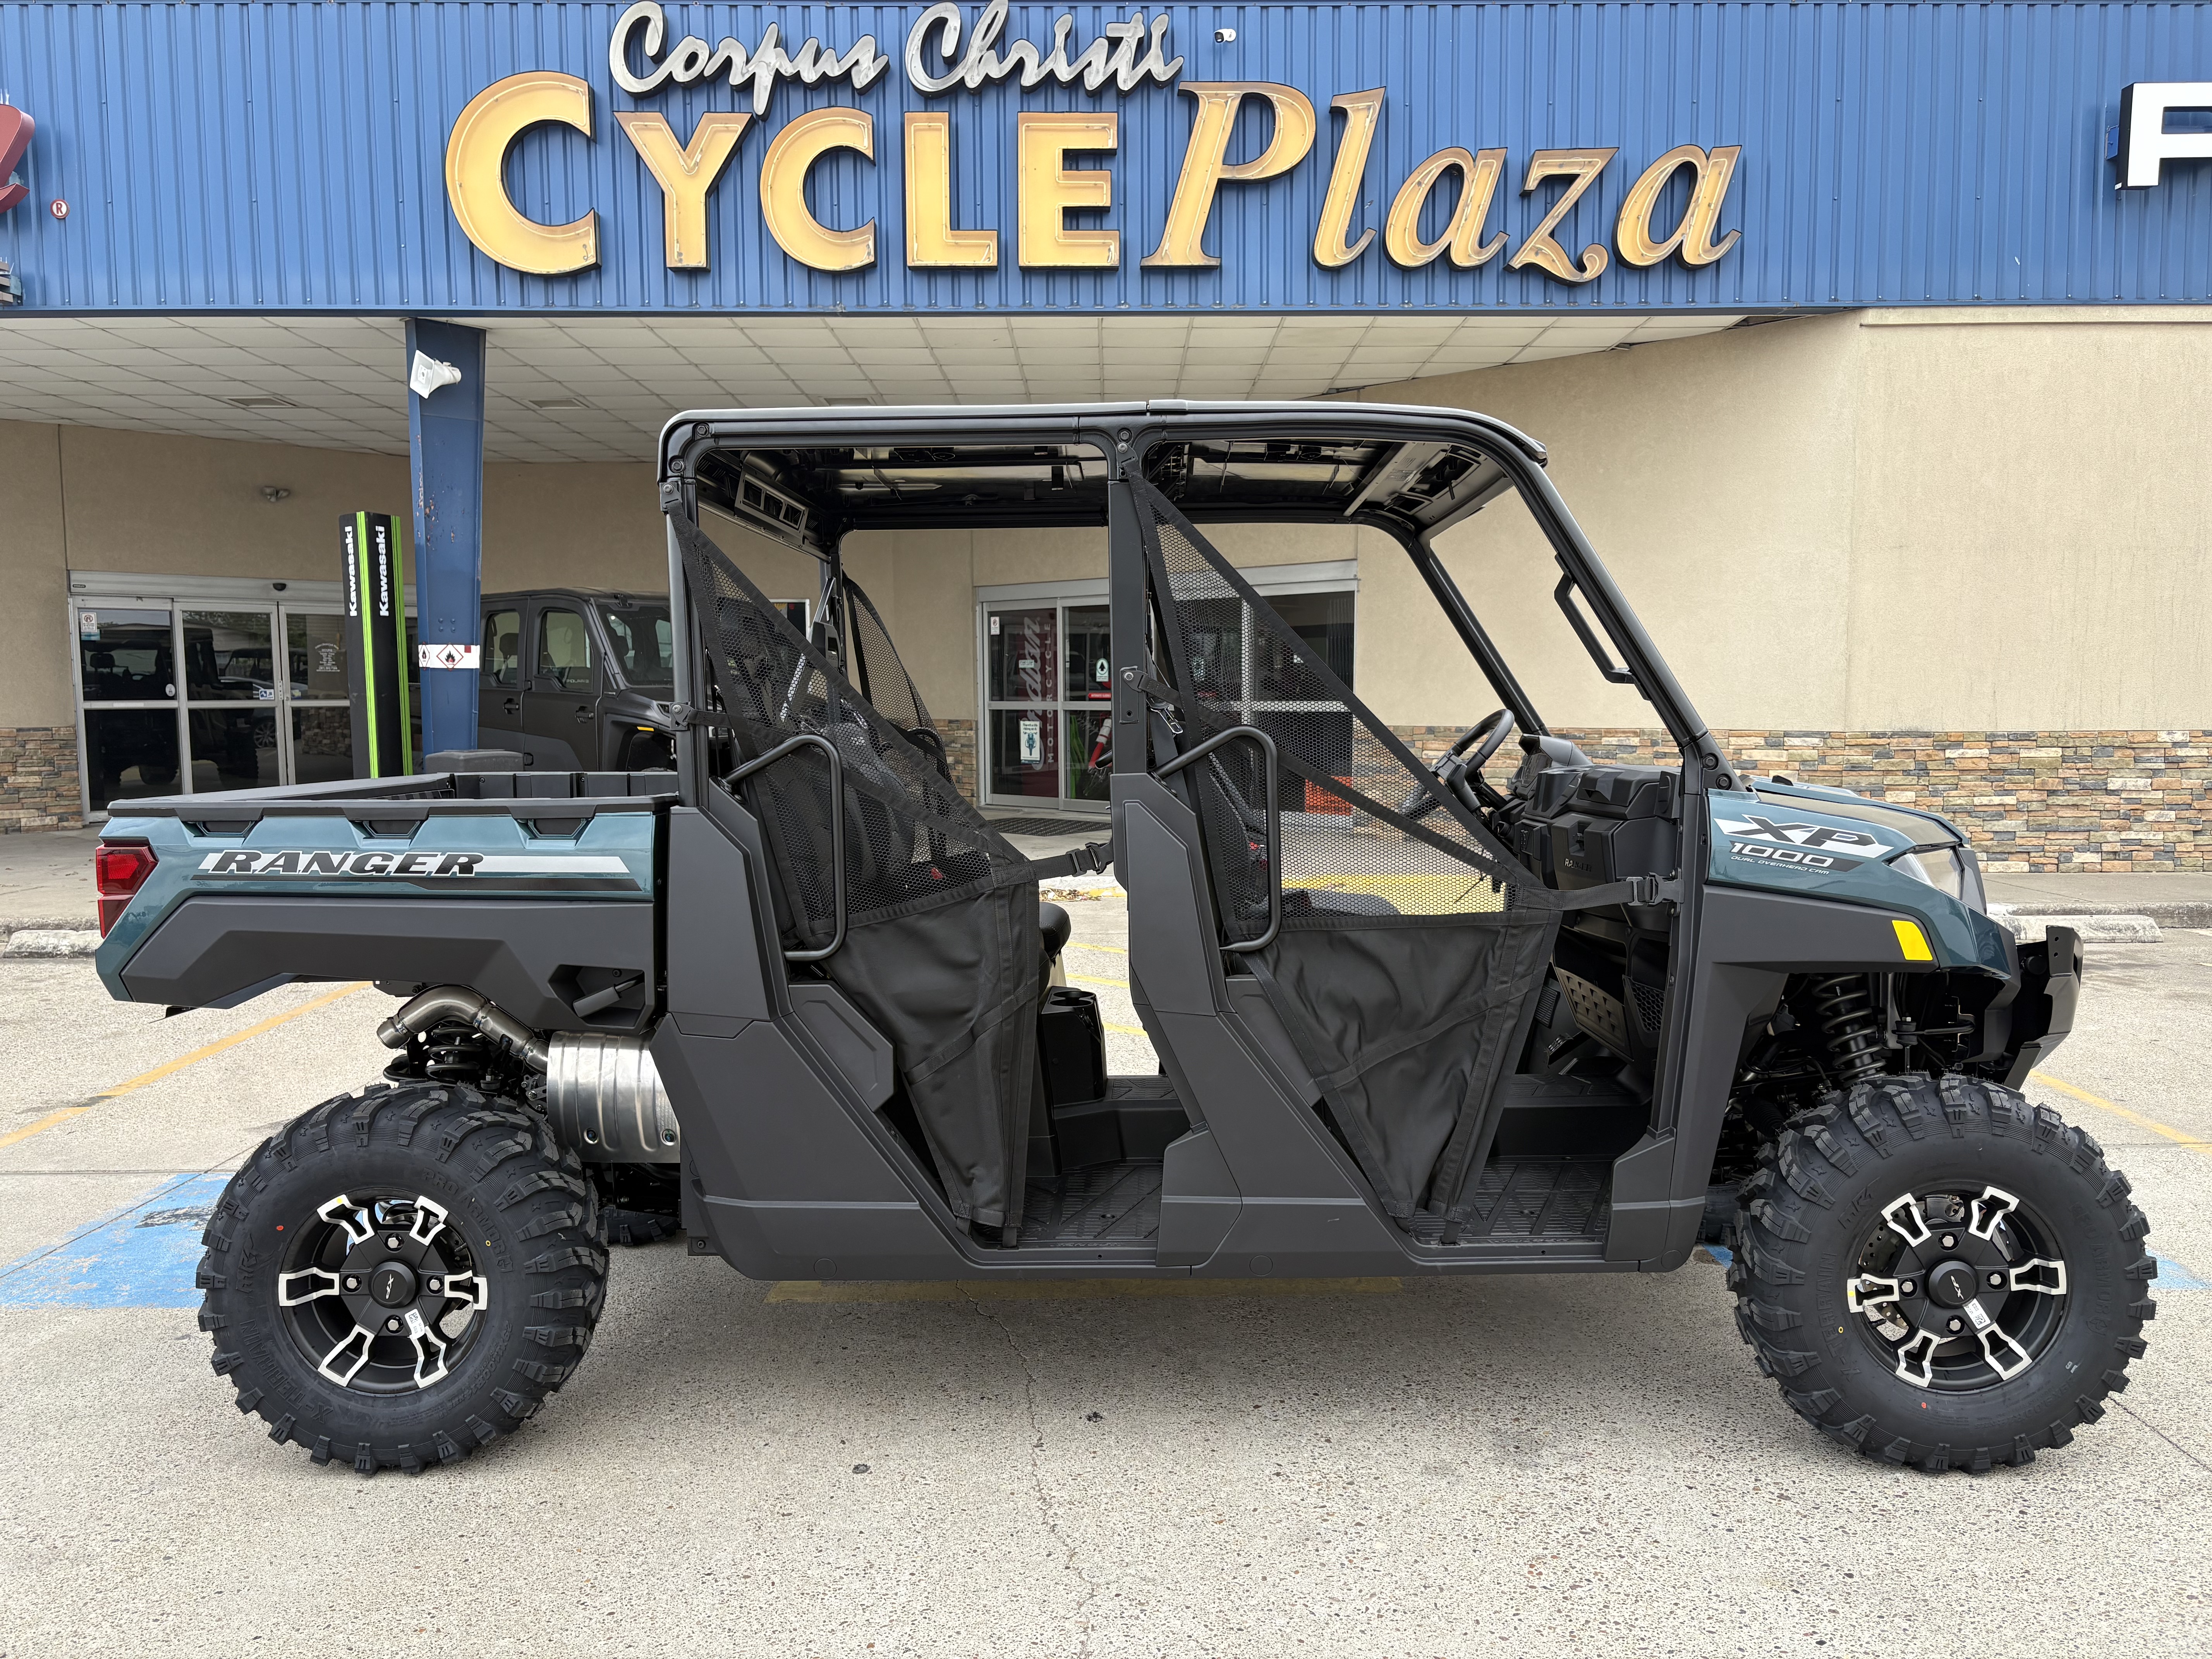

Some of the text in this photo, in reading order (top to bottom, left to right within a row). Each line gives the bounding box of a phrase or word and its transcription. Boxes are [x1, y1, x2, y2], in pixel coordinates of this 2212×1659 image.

[609, 0, 1184, 116] Corpus Christi
[445, 71, 1743, 286] CYCLE Plaza
[345, 526, 357, 616] Kawasaki
[376, 526, 389, 616] Kawasaki
[1044, 623, 1054, 763] MOTORCYCLE
[208, 850, 484, 876] RANGER
[1726, 816, 1876, 847] XP
[1731, 842, 1834, 867] 1000
[1757, 860, 1808, 871] OVERHEAD
[422, 1167, 505, 1255] PRO ARMOR
[239, 1319, 334, 1424] X-TERRAIN
